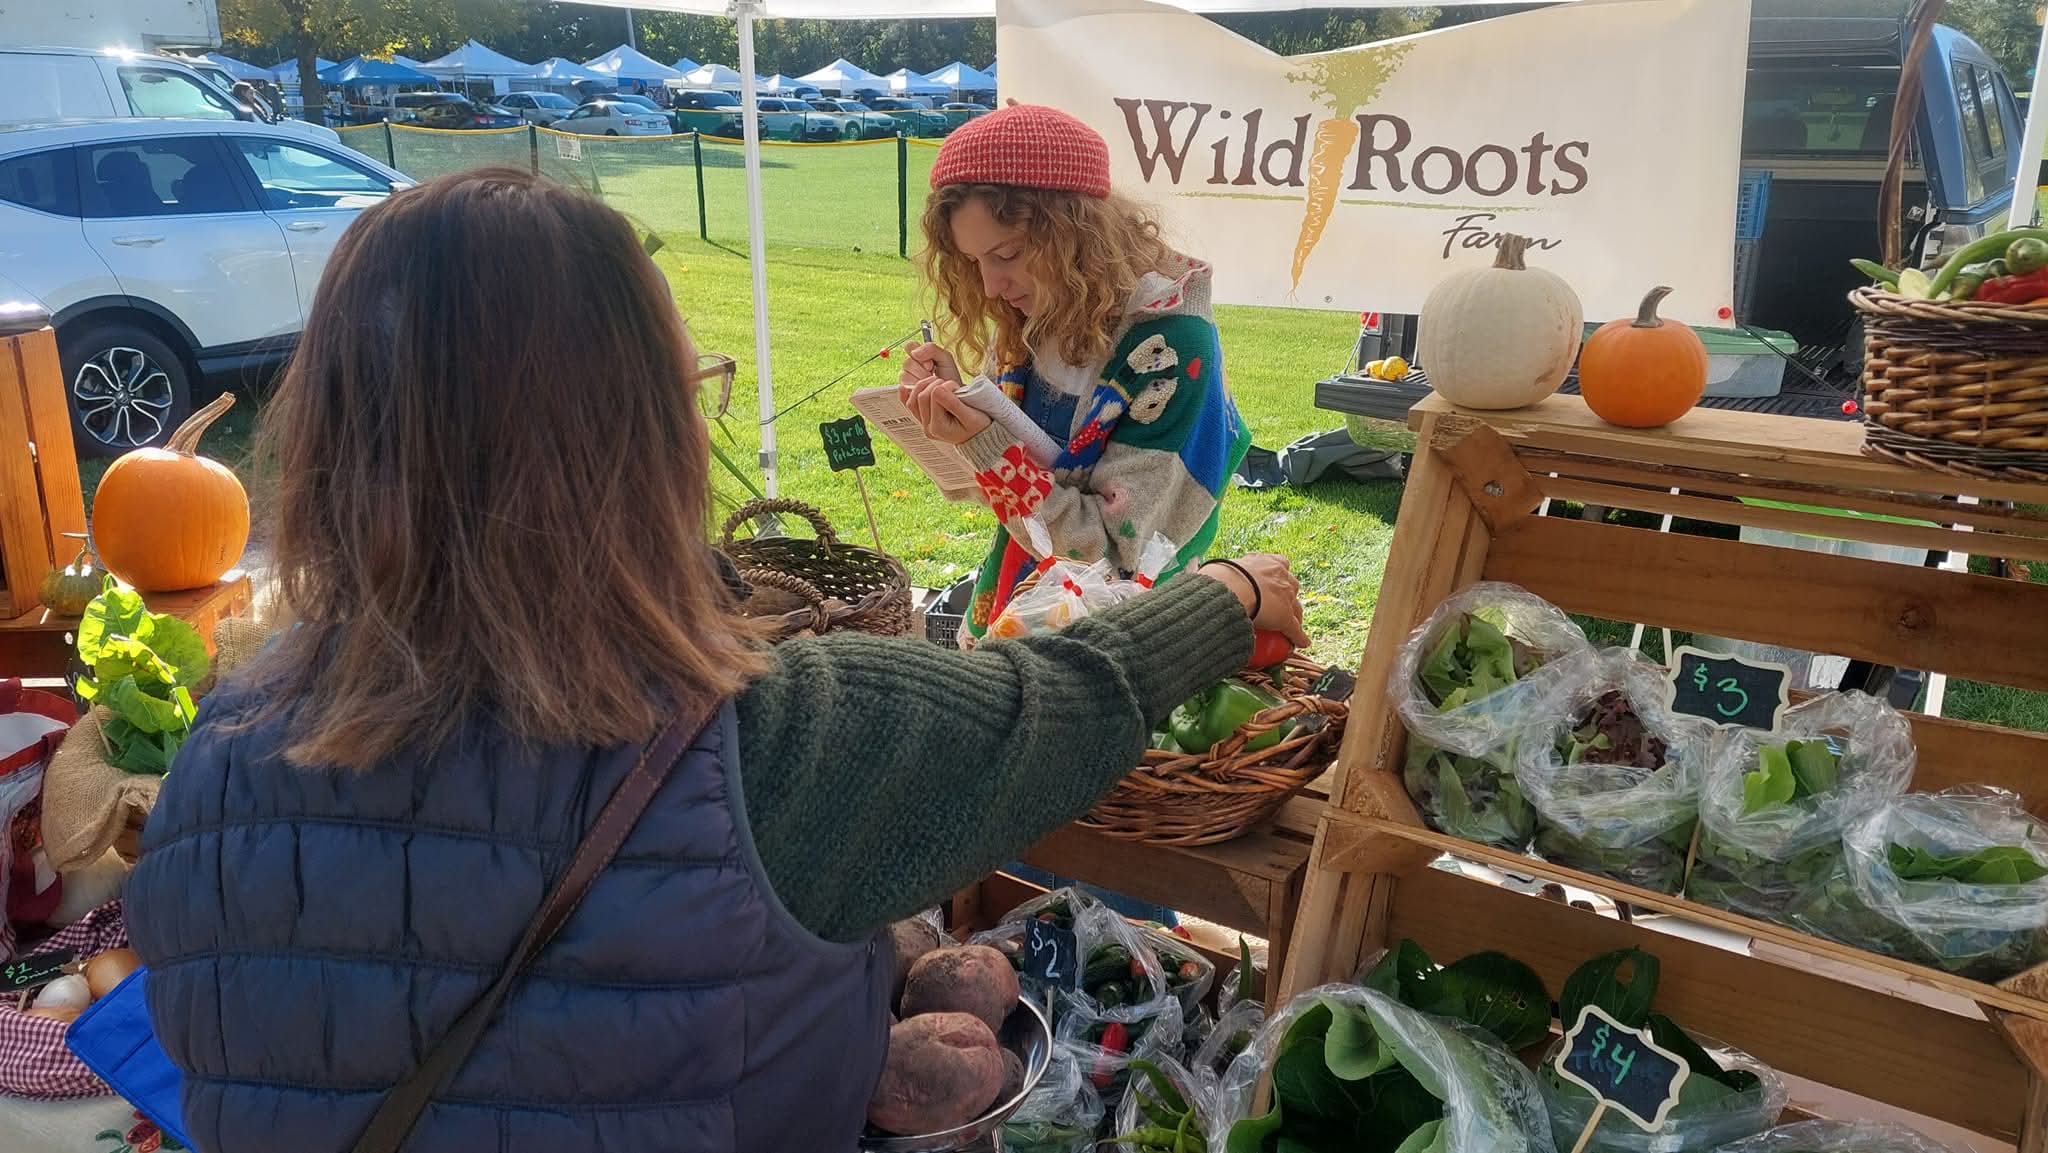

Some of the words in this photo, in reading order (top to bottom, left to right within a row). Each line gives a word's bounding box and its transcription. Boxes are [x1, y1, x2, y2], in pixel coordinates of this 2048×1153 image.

[1113, 98, 1312, 187] Wild
[1347, 114, 1589, 197] Roots
[1693, 662, 1748, 716] $3
[4, 962, 33, 979] $1
[1031, 920, 1061, 978] $2
[1591, 1024, 1636, 1085] $4
